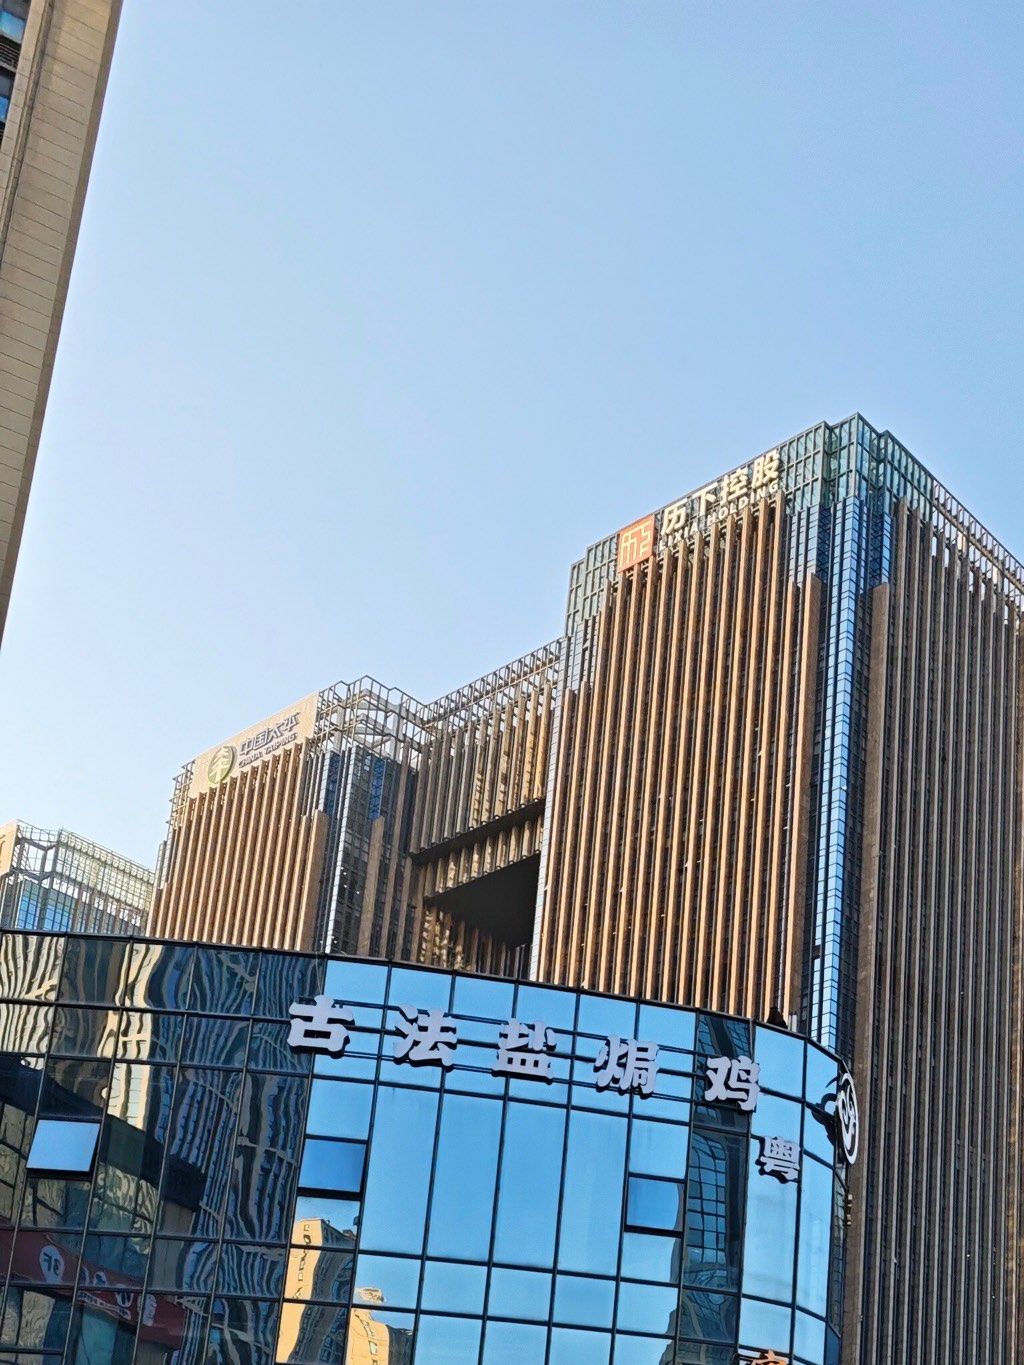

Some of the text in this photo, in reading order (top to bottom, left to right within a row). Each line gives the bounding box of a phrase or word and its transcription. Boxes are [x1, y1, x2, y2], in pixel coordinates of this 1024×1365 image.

[660, 449, 780, 536] 历下控股
[660, 522, 700, 551] LIXIA
[707, 482, 779, 527] HOLDING
[240, 711, 301, 756] 中国太平
[286, 994, 762, 1111] 古法盐焗鸡
[757, 1134, 801, 1181] 粤
